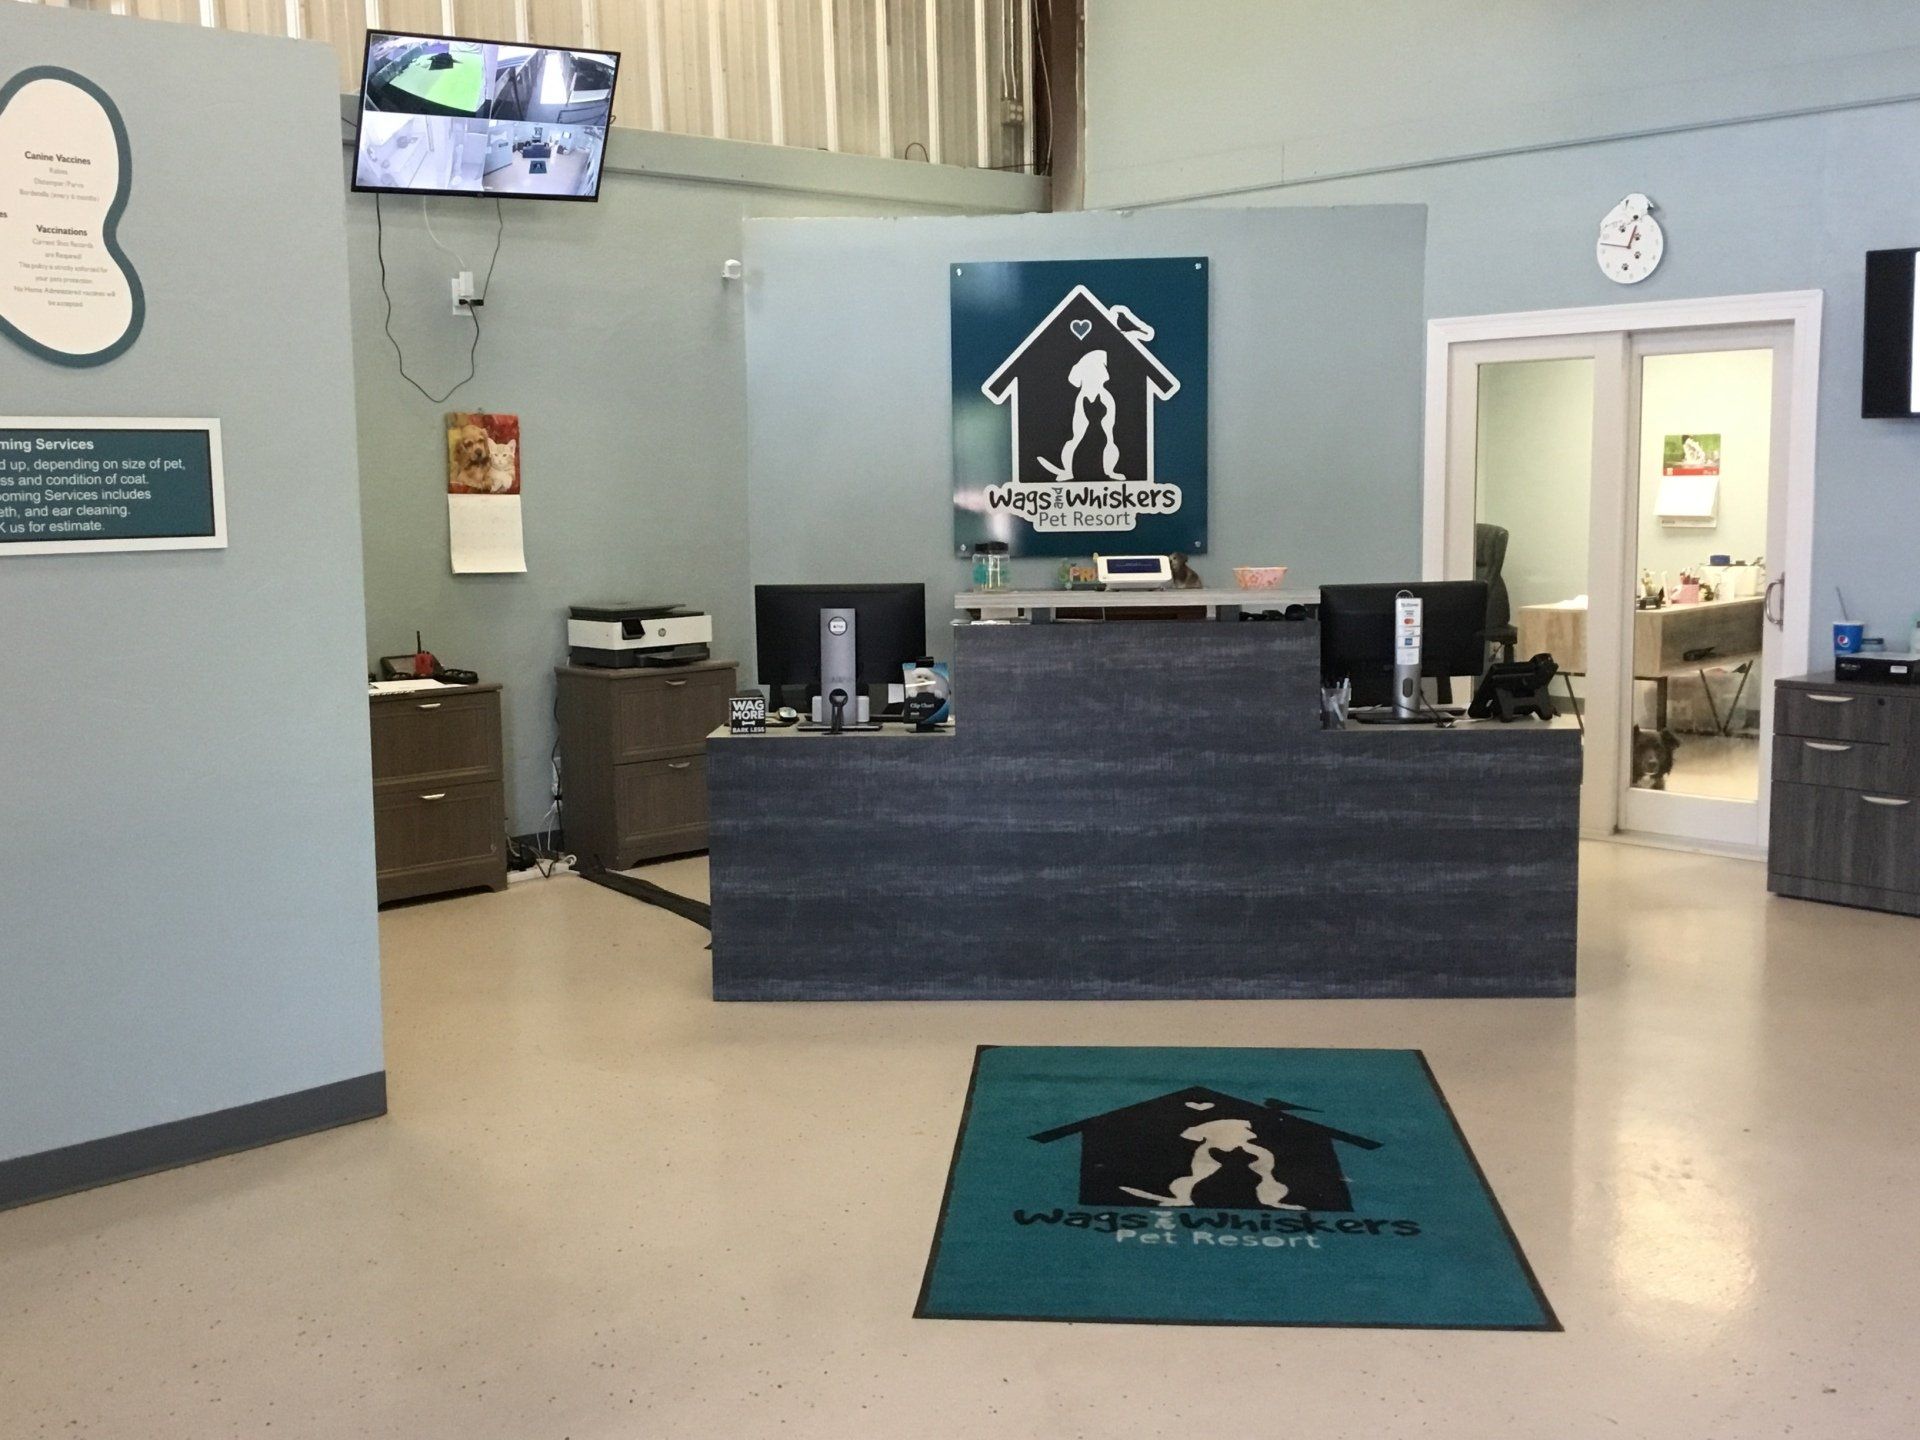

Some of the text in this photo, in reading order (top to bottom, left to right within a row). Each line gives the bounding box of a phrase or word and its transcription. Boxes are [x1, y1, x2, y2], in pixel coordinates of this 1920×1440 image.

[24, 150, 92, 166] Canine Vaccines
[36, 224, 88, 237] Vaccinations
[36, 438, 94, 450] Services
[10, 462, 30, 472] up,
[34, 459, 100, 472] depending
[103, 460, 118, 470] on
[122, 458, 146, 470] size
[150, 458, 160, 470] of
[164, 458, 186, 473] pet,
[18, 475, 42, 486] and
[46, 474, 102, 486] condition
[105, 474, 117, 485] of
[120, 474, 150, 486] coat.
[44, 490, 98, 501] Services
[102, 488, 152, 500] includes
[989, 484, 1176, 516] Wags and Whiskers
[0, 504, 131, 519] eth, and ear cleaning.
[1039, 510, 1130, 526] Pet Resort
[10, 524, 25, 533] us
[29, 521, 45, 532] for
[50, 521, 105, 532] estimate.
[732, 700, 764, 711] WAG
[732, 710, 764, 720] MORE
[1014, 1208, 1148, 1233] Wags
[1180, 1212, 1422, 1237] Whiskers
[1116, 1229, 1321, 1249] Pet Resort
